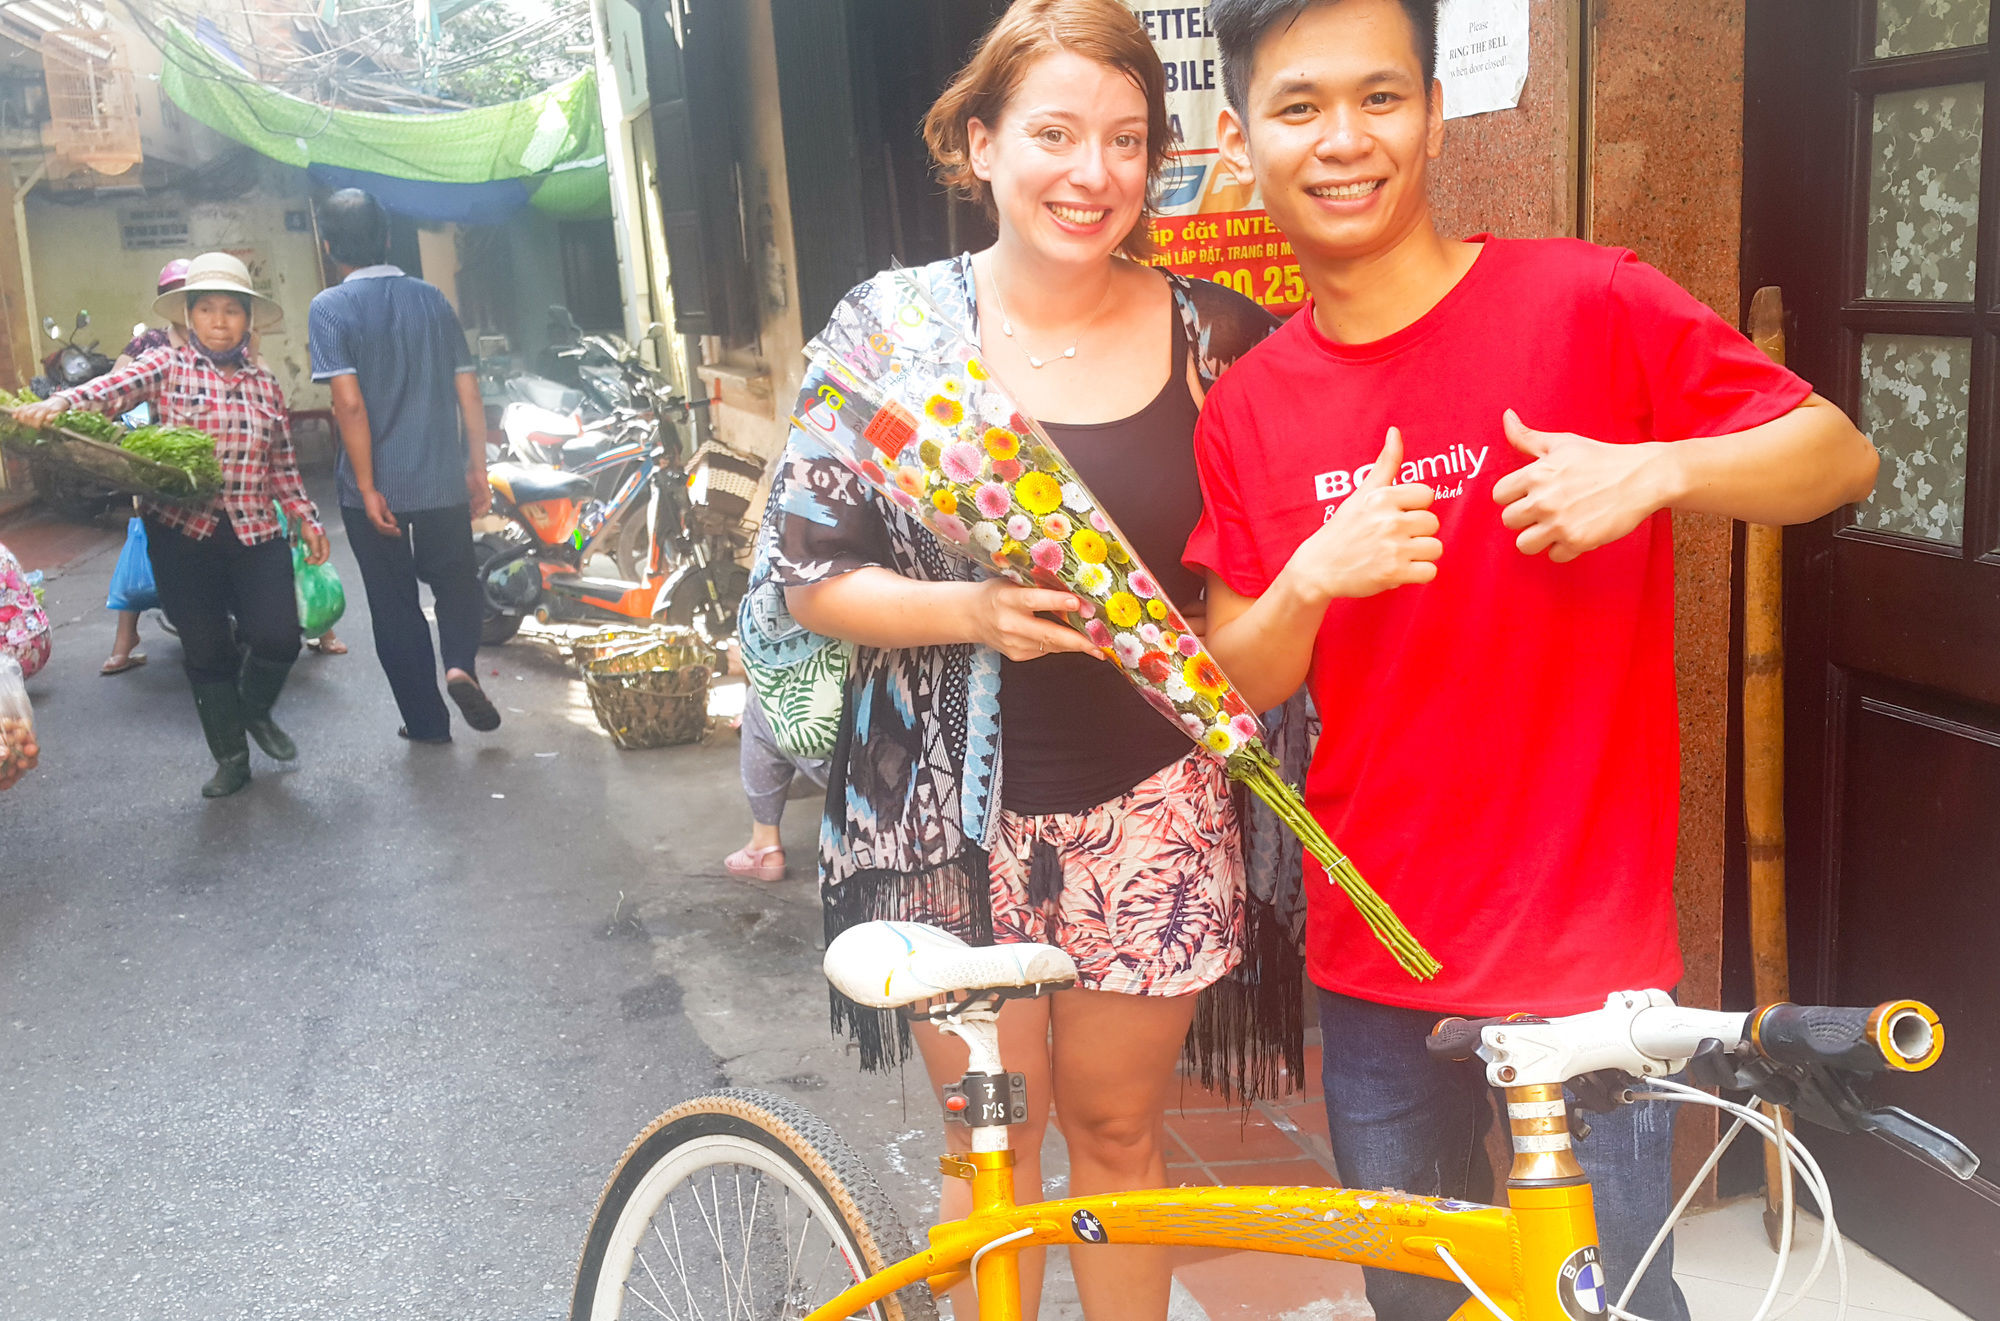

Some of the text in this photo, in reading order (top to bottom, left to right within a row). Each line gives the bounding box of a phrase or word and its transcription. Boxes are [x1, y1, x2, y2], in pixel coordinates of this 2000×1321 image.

[1134, 7, 1214, 40] ETTEL
[1468, 20, 1489, 33] Please
[1449, 35, 1509, 60] RING THE BELL
[1450, 55, 1507, 79] when door closed!
[1181, 221, 1219, 245] đặt
[1226, 216, 1282, 237] INTE
[1227, 243, 1264, 261] TRANG
[1266, 242, 1279, 260] BỊ
[1392, 443, 1489, 486] amily
[1432, 480, 1463, 500] hành
[983, 1083, 996, 1099] 7
[1072, 1210, 1101, 1226] BMW
